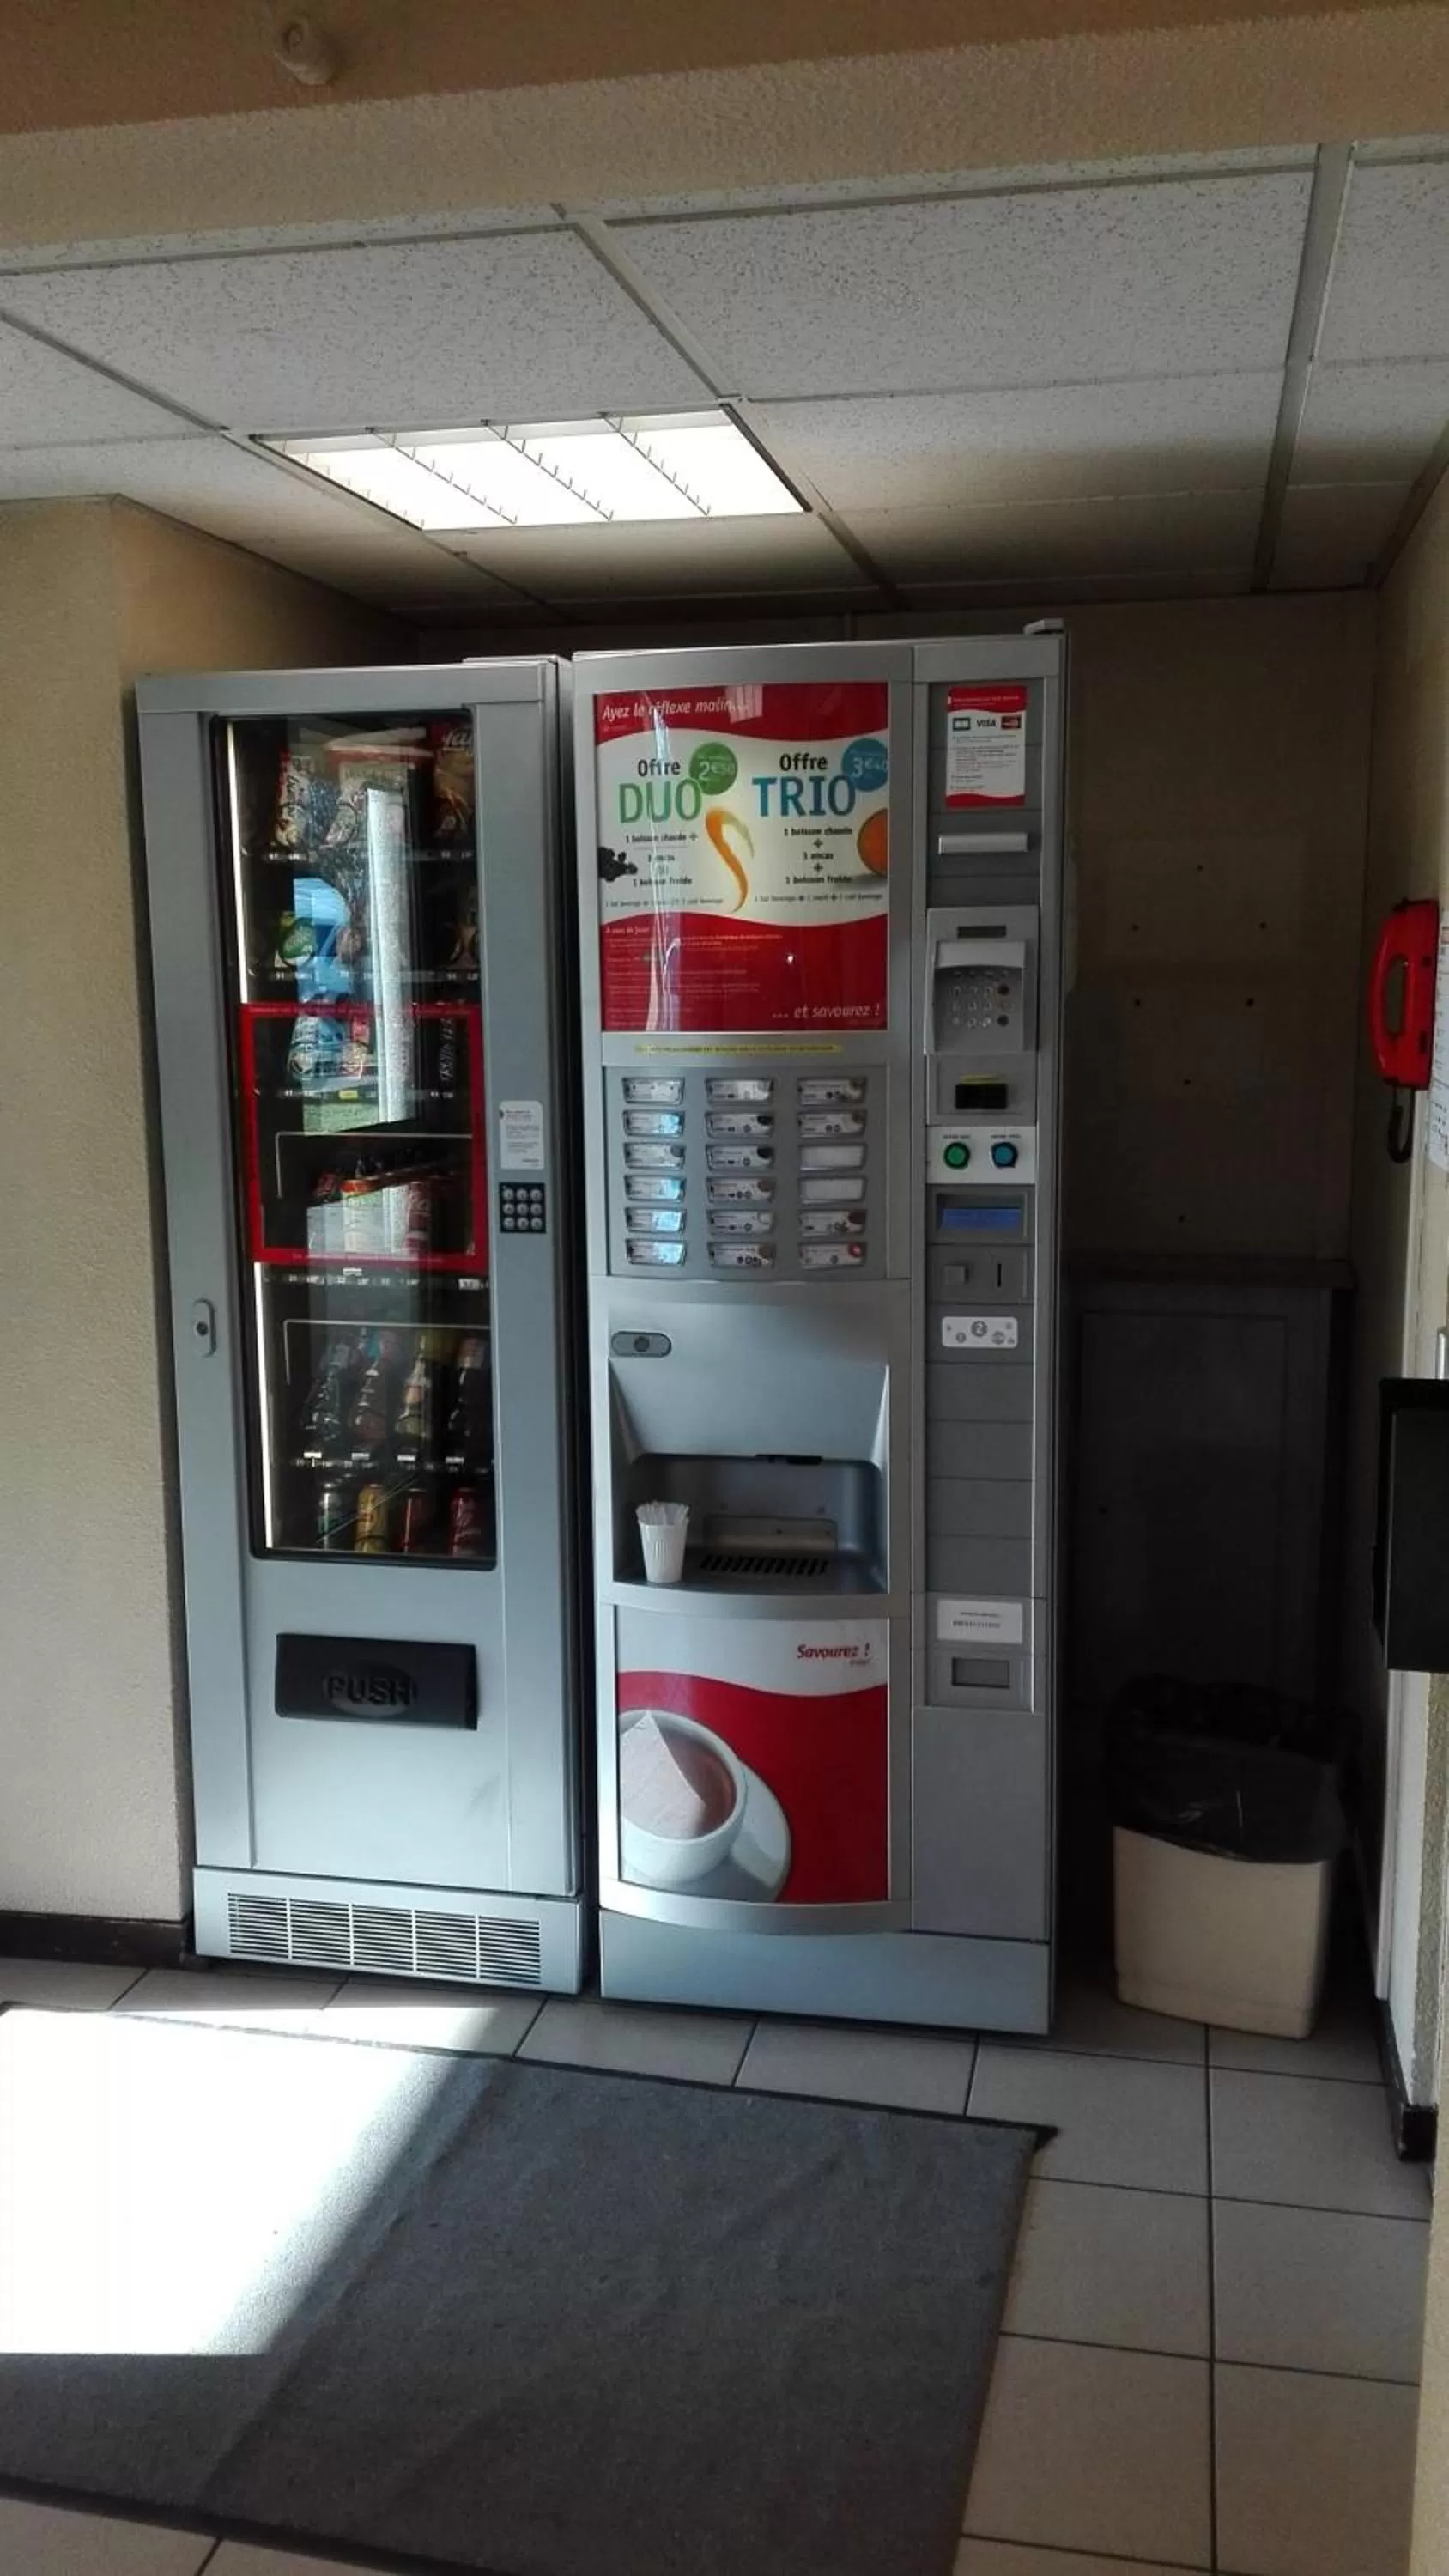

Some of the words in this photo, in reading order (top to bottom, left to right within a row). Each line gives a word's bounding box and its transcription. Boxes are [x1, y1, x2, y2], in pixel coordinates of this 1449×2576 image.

[603, 704, 630, 721] Ayez
[634, 704, 645, 717] le
[638, 758, 681, 777] Offre
[779, 752, 828, 772] Offre
[619, 777, 702, 824] DUO
[752, 774, 857, 817] TRIO
[793, 1003, 809, 1018] et
[811, 1005, 870, 1018] savourez
[797, 1643, 859, 1659] Savourez
[324, 1673, 417, 1706] PUSH
